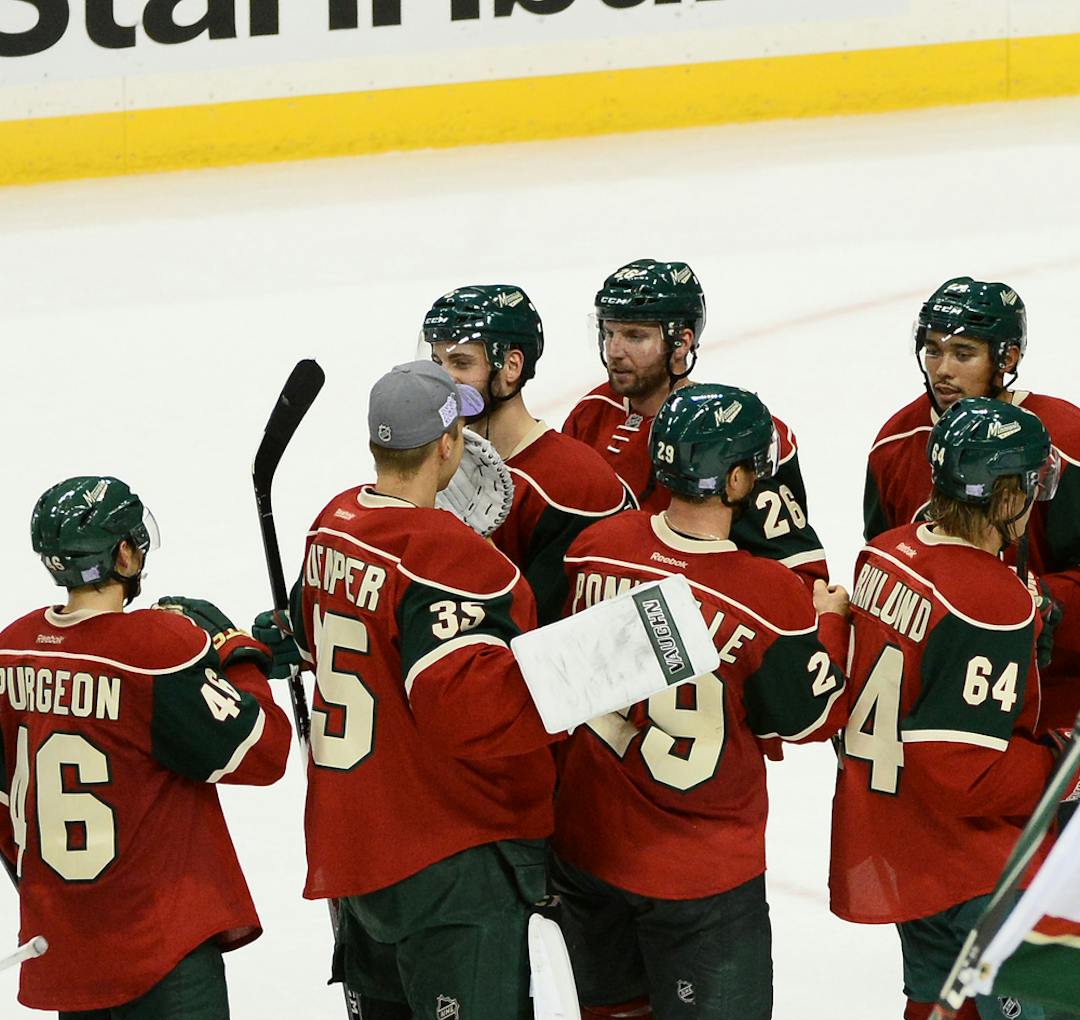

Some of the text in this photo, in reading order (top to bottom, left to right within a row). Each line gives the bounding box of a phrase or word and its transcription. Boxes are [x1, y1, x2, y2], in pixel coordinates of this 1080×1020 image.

[600, 296, 632, 305] CCM
[657, 440, 675, 464] 29
[931, 443, 946, 467] 64
[756, 485, 806, 540] 26
[650, 552, 689, 569] Reebok
[429, 599, 487, 640] 35
[643, 599, 686, 675] VAUGHN
[201, 667, 241, 722] 46
[303, 600, 376, 772] 5
[807, 651, 837, 697] 2
[962, 655, 1019, 713] 64
[844, 622, 905, 795] 4
